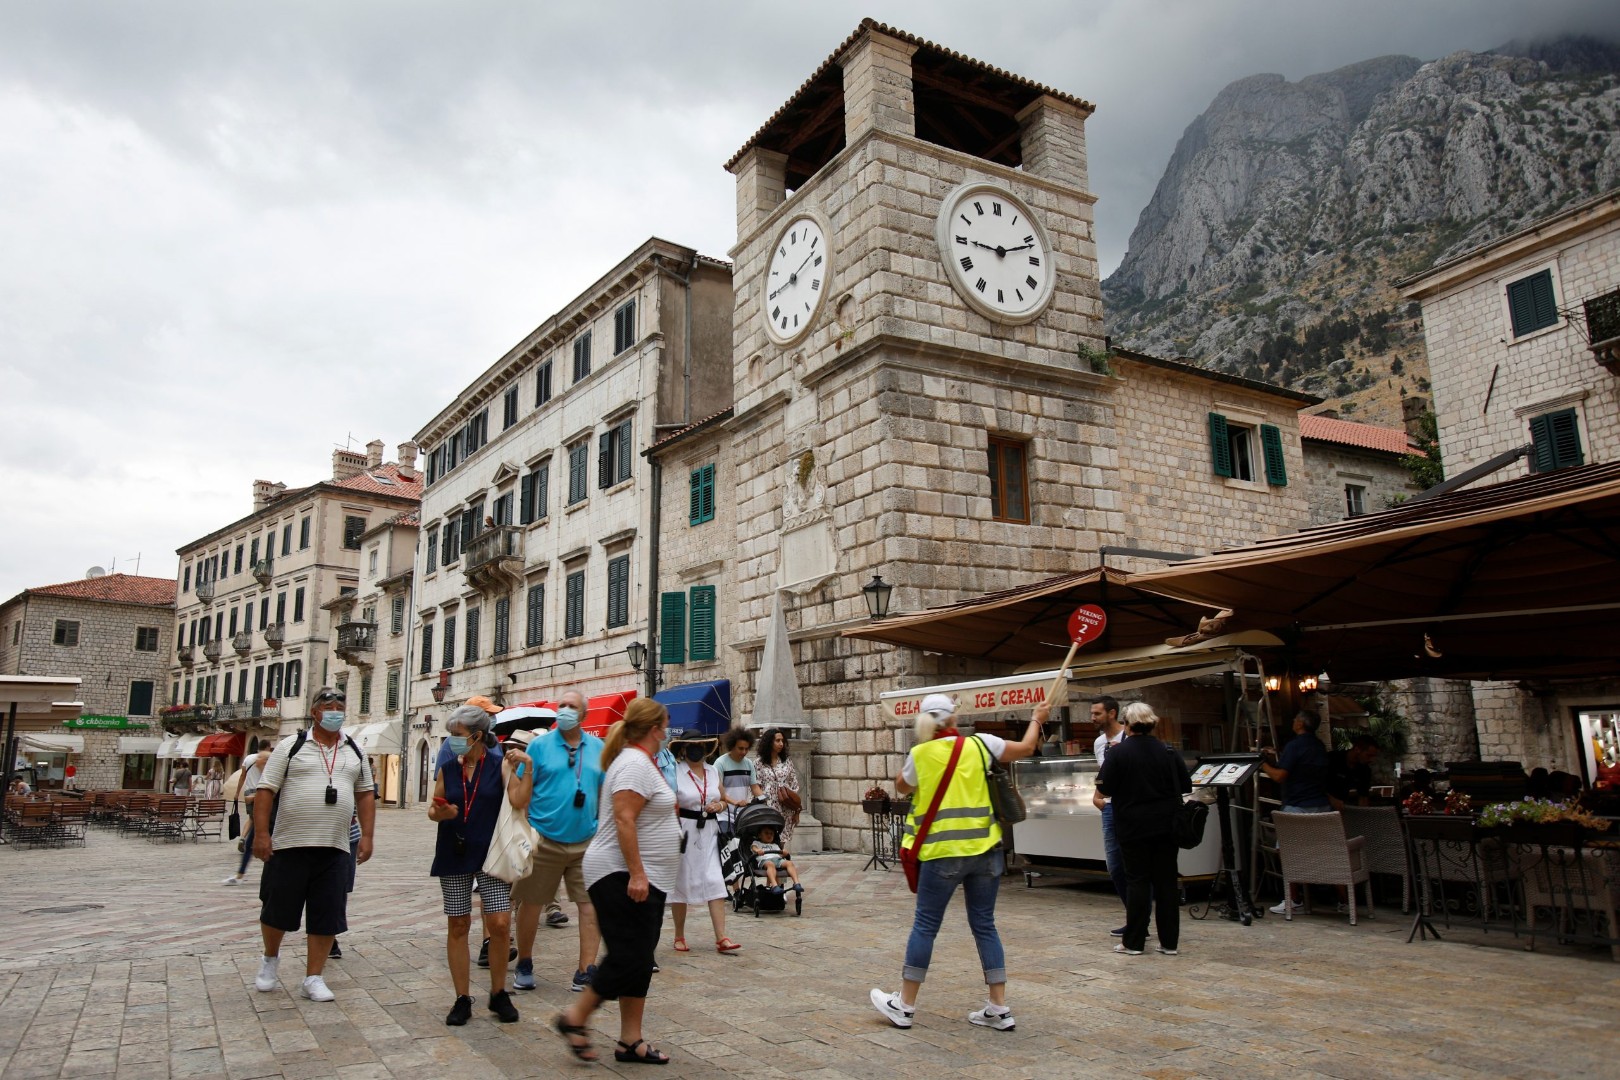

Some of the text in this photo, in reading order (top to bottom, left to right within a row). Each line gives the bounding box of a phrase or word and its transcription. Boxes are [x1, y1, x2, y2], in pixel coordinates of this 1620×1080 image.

[960, 214, 971, 226] X
[1012, 216, 1018, 225] I
[956, 235, 967, 245] IX
[1024, 235, 1034, 243] II
[1029, 256, 1040, 266] III
[1079, 608, 1104, 620] VIKING
[1077, 615, 1099, 626] VENUS
[1078, 623, 1088, 634] 2
[895, 686, 1046, 716] GELA ICE CREAM
